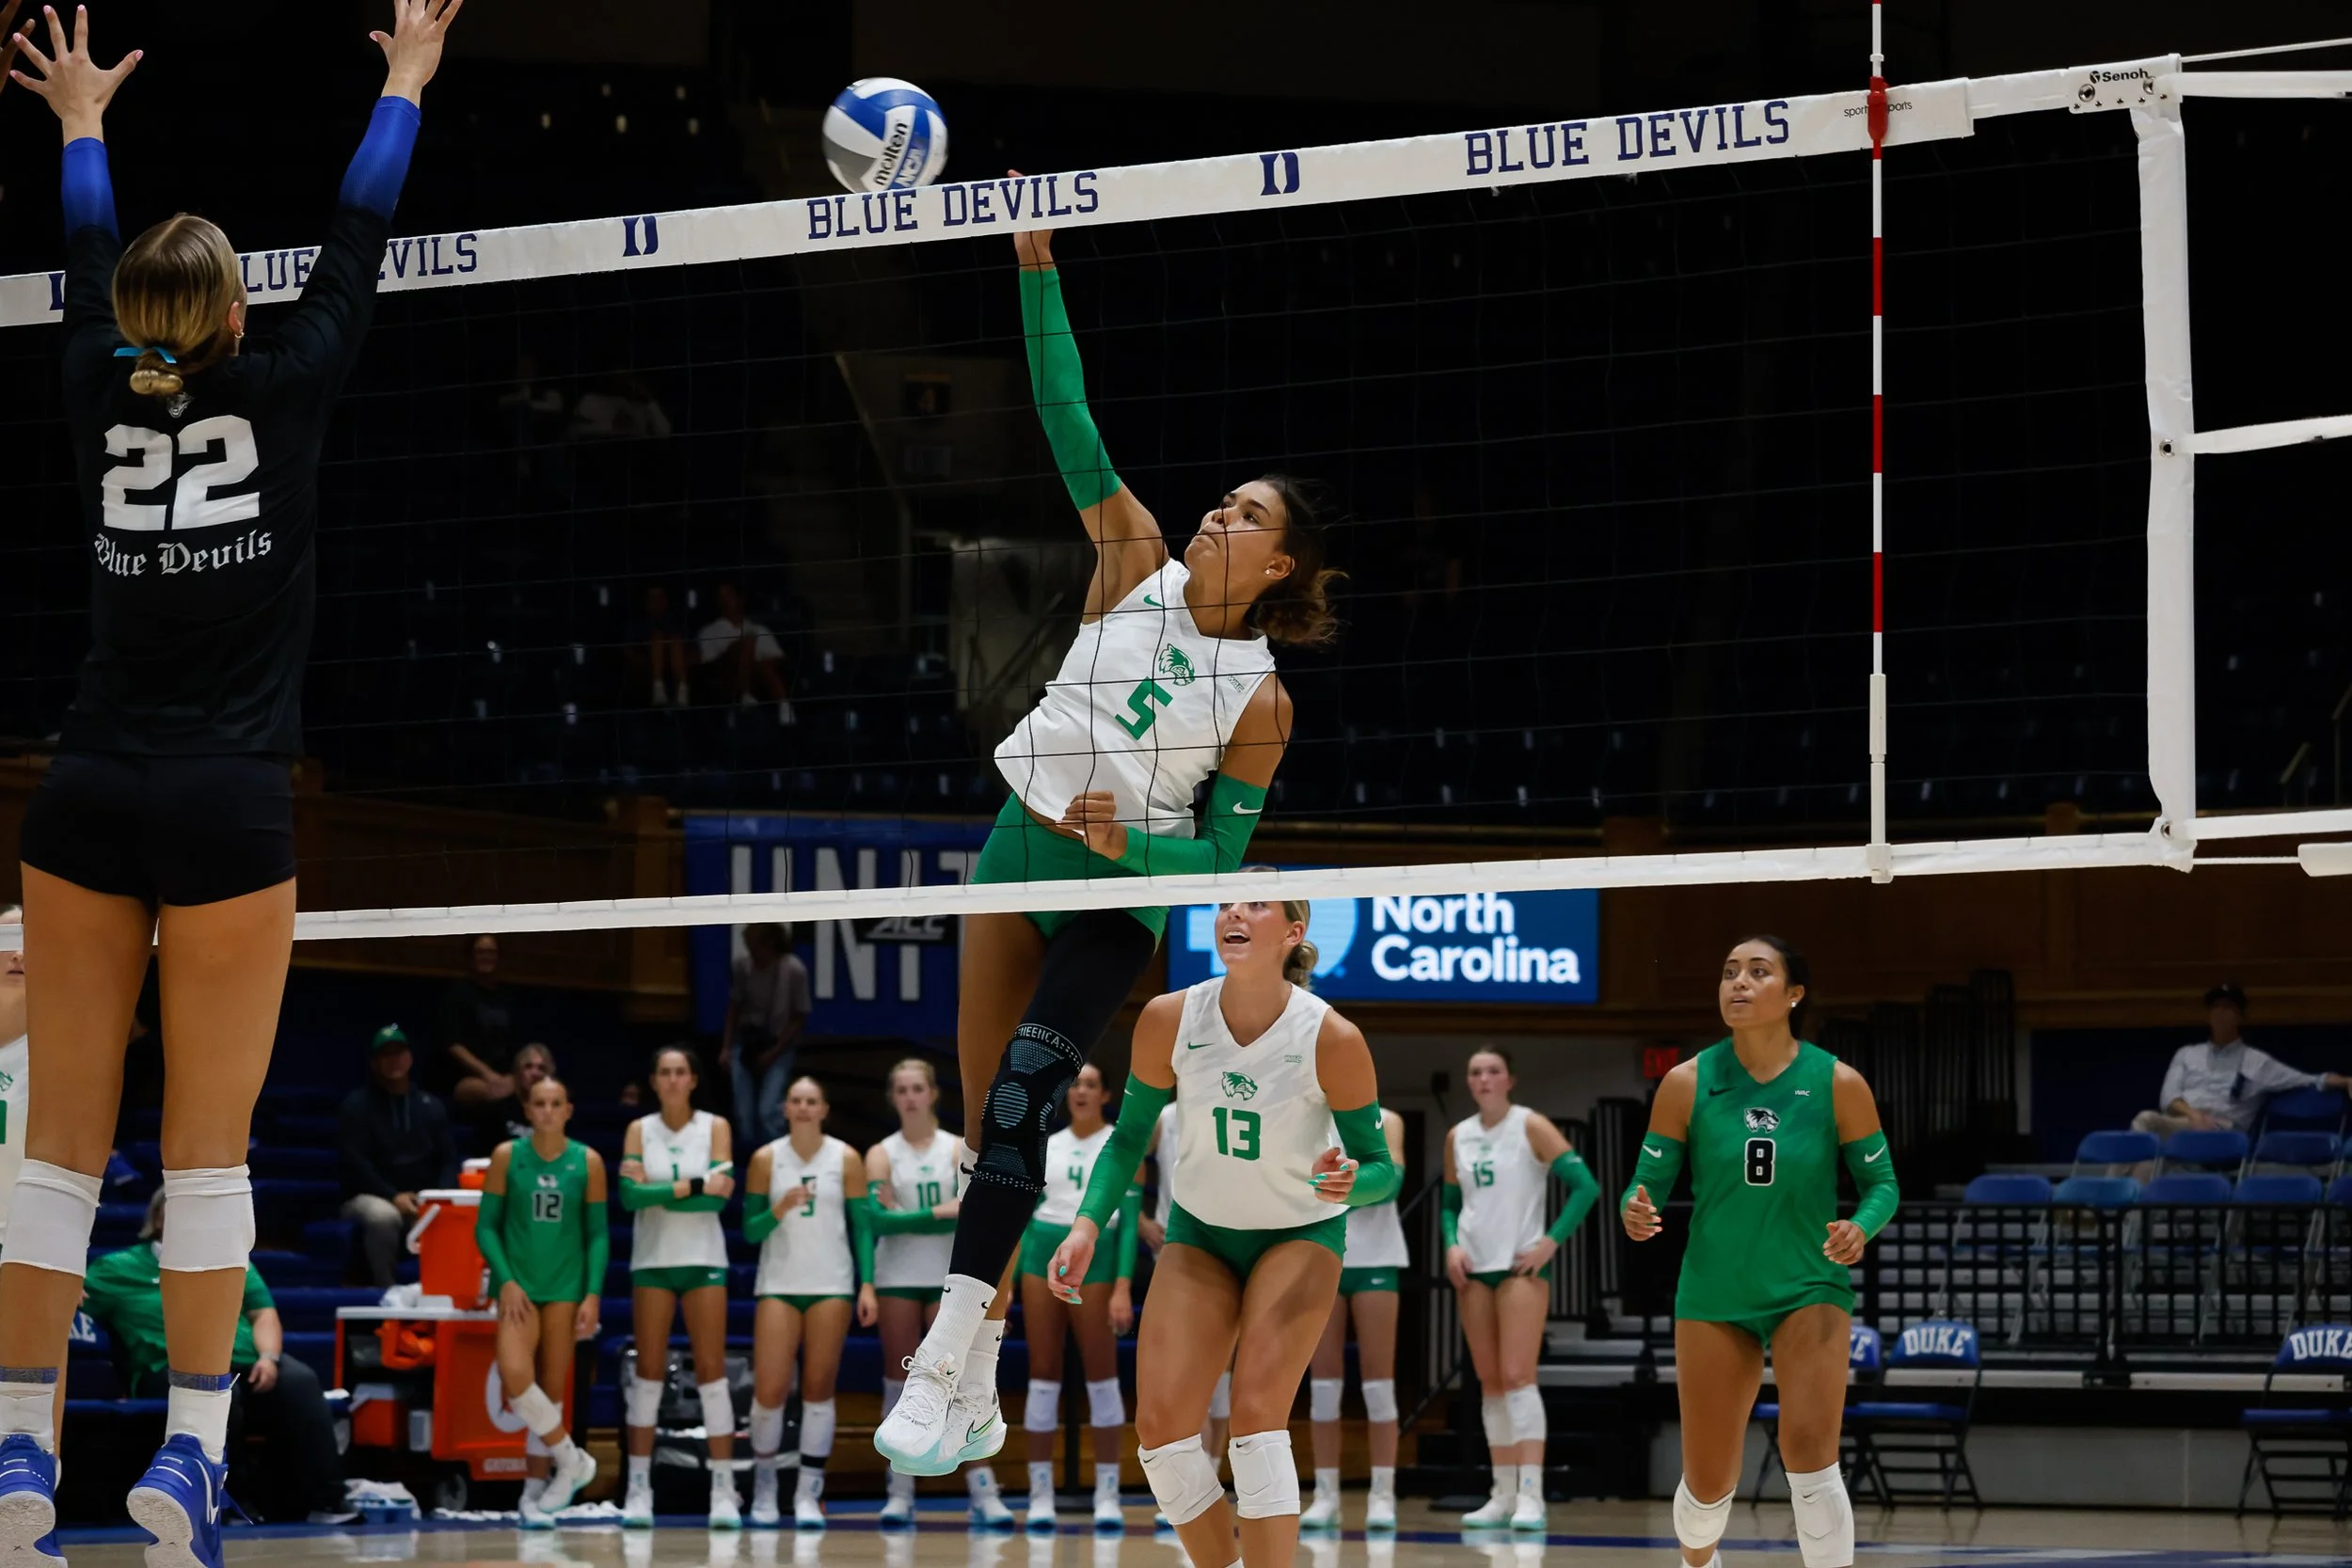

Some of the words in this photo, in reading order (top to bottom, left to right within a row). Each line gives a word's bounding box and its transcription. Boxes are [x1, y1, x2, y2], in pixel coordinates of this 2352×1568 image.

[2102, 68, 2149, 83] Senoh
[1843, 104, 1869, 119] sport
[873, 122, 909, 186] molten
[1465, 121, 1590, 176] BLUE
[1615, 100, 1790, 161] DEVILS
[807, 189, 919, 241] BLUE
[942, 171, 1100, 227] DEVILS
[240, 248, 317, 293] LUE
[376, 232, 478, 280] VILS
[101, 414, 262, 532] 22
[94, 532, 148, 577] Blue
[157, 529, 273, 576] Devils
[1114, 676, 1174, 740] 5
[1371, 892, 1516, 934] North
[1371, 933, 1581, 985] Carolina
[1212, 1106, 1262, 1162] 13
[1067, 1165, 1084, 1191] 4
[1472, 1160, 1495, 1189] 15
[1744, 1136, 1776, 1187] 8
[532, 1190, 564, 1223] 12
[916, 1181, 941, 1209] 10
[1903, 1326, 1972, 1357] DUKE
[2289, 1329, 2352, 1361] DUKE
